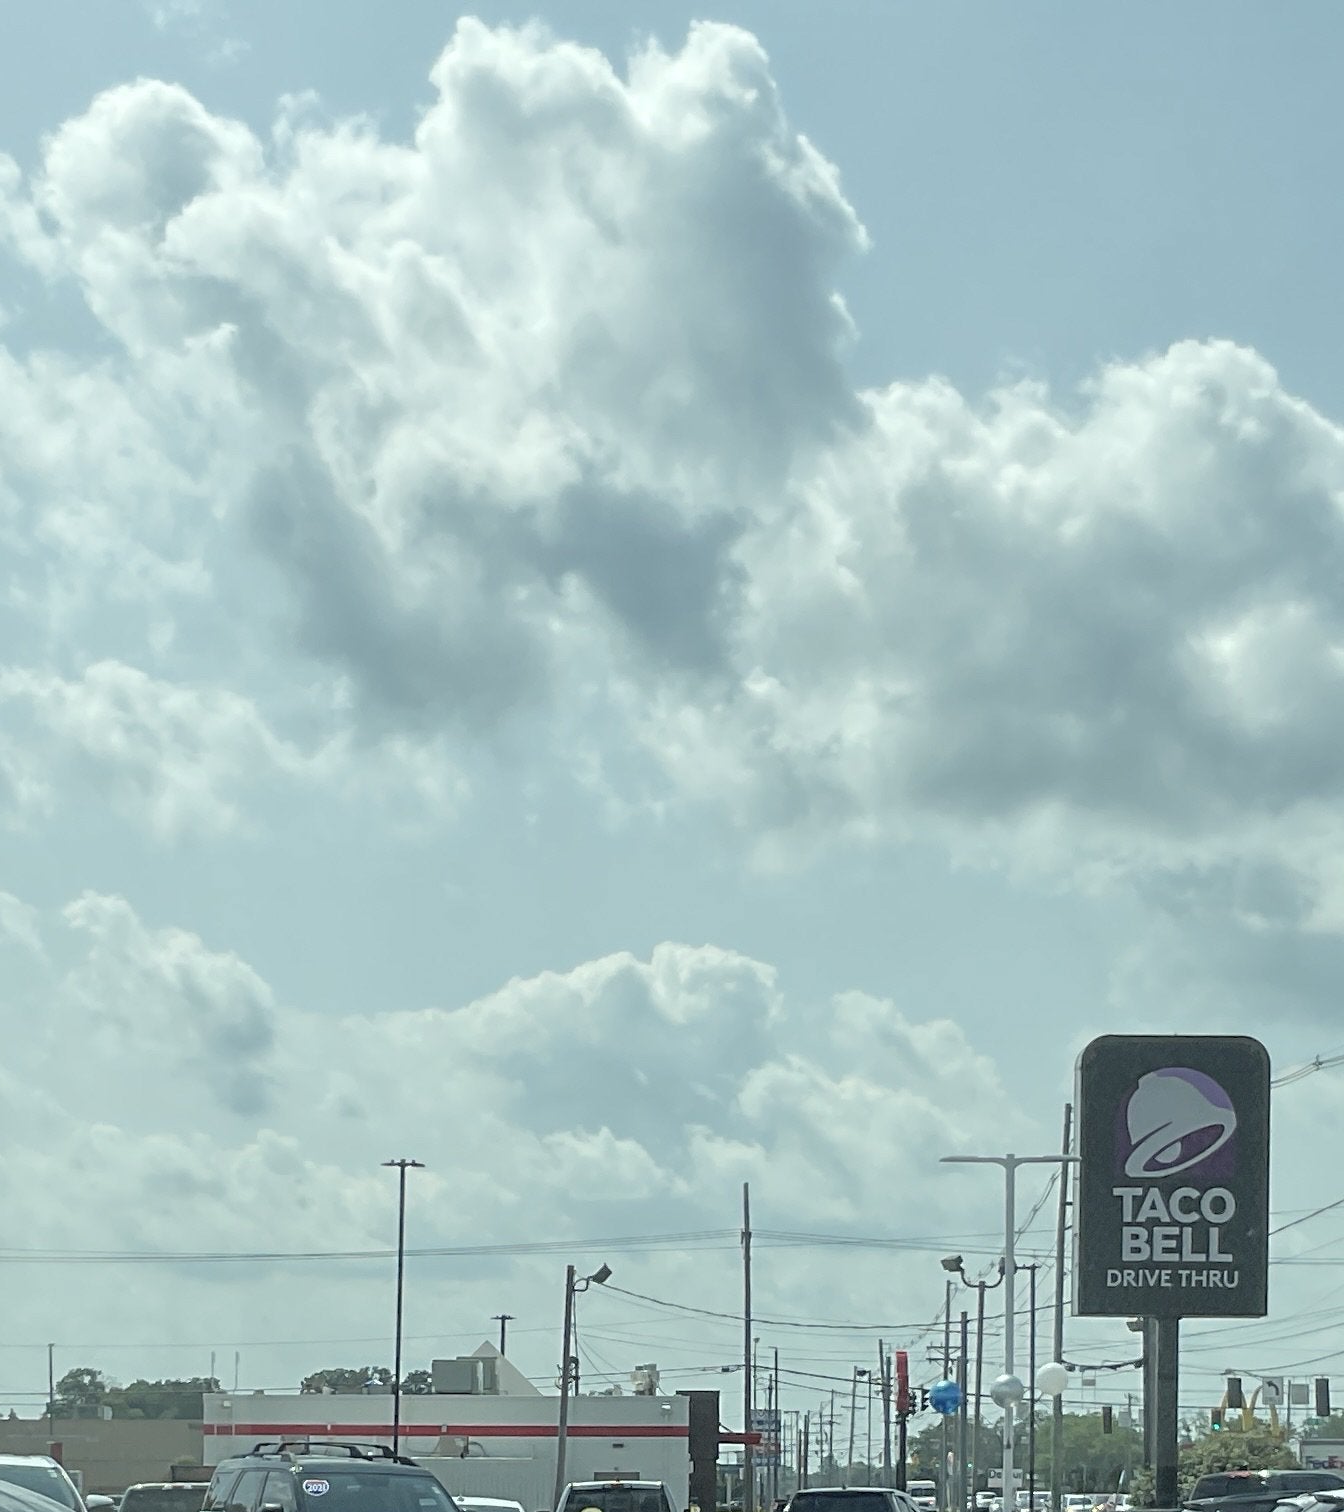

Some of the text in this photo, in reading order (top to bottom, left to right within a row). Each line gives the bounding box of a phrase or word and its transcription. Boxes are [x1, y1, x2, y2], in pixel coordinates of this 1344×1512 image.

[1112, 1186, 1236, 1224] TACO
[1121, 1226, 1233, 1263] BELL
[1106, 1269, 1239, 1289] DRIVE THRU
